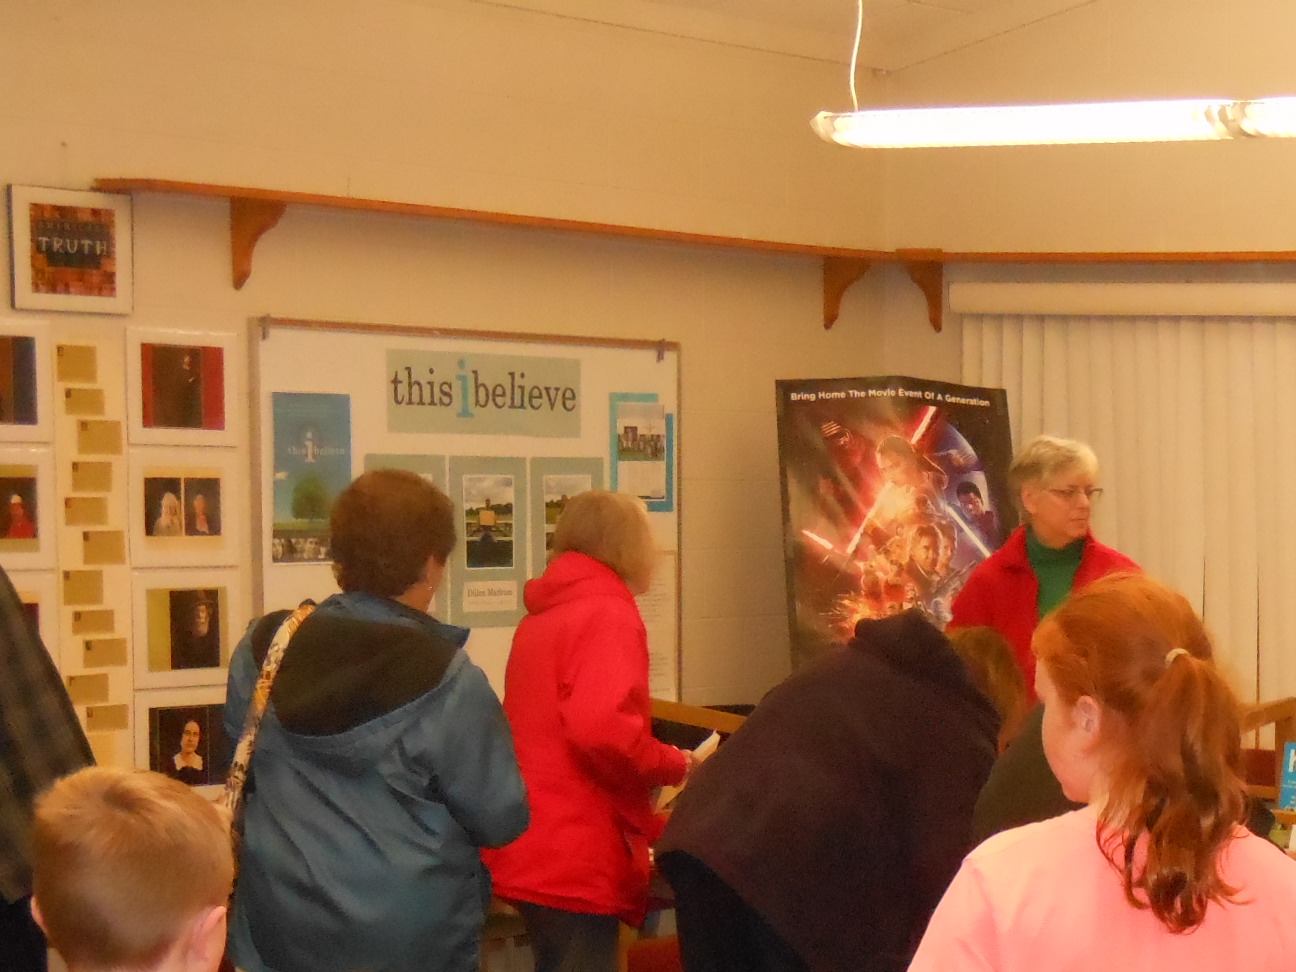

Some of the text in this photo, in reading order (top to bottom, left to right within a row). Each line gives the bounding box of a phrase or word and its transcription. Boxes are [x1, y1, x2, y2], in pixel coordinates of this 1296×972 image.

[38, 236, 108, 256] TRUTH
[390, 366, 453, 407] this
[471, 369, 577, 412] believe
[790, 388, 990, 407] Bring Home The Movie Event Of A Generation
